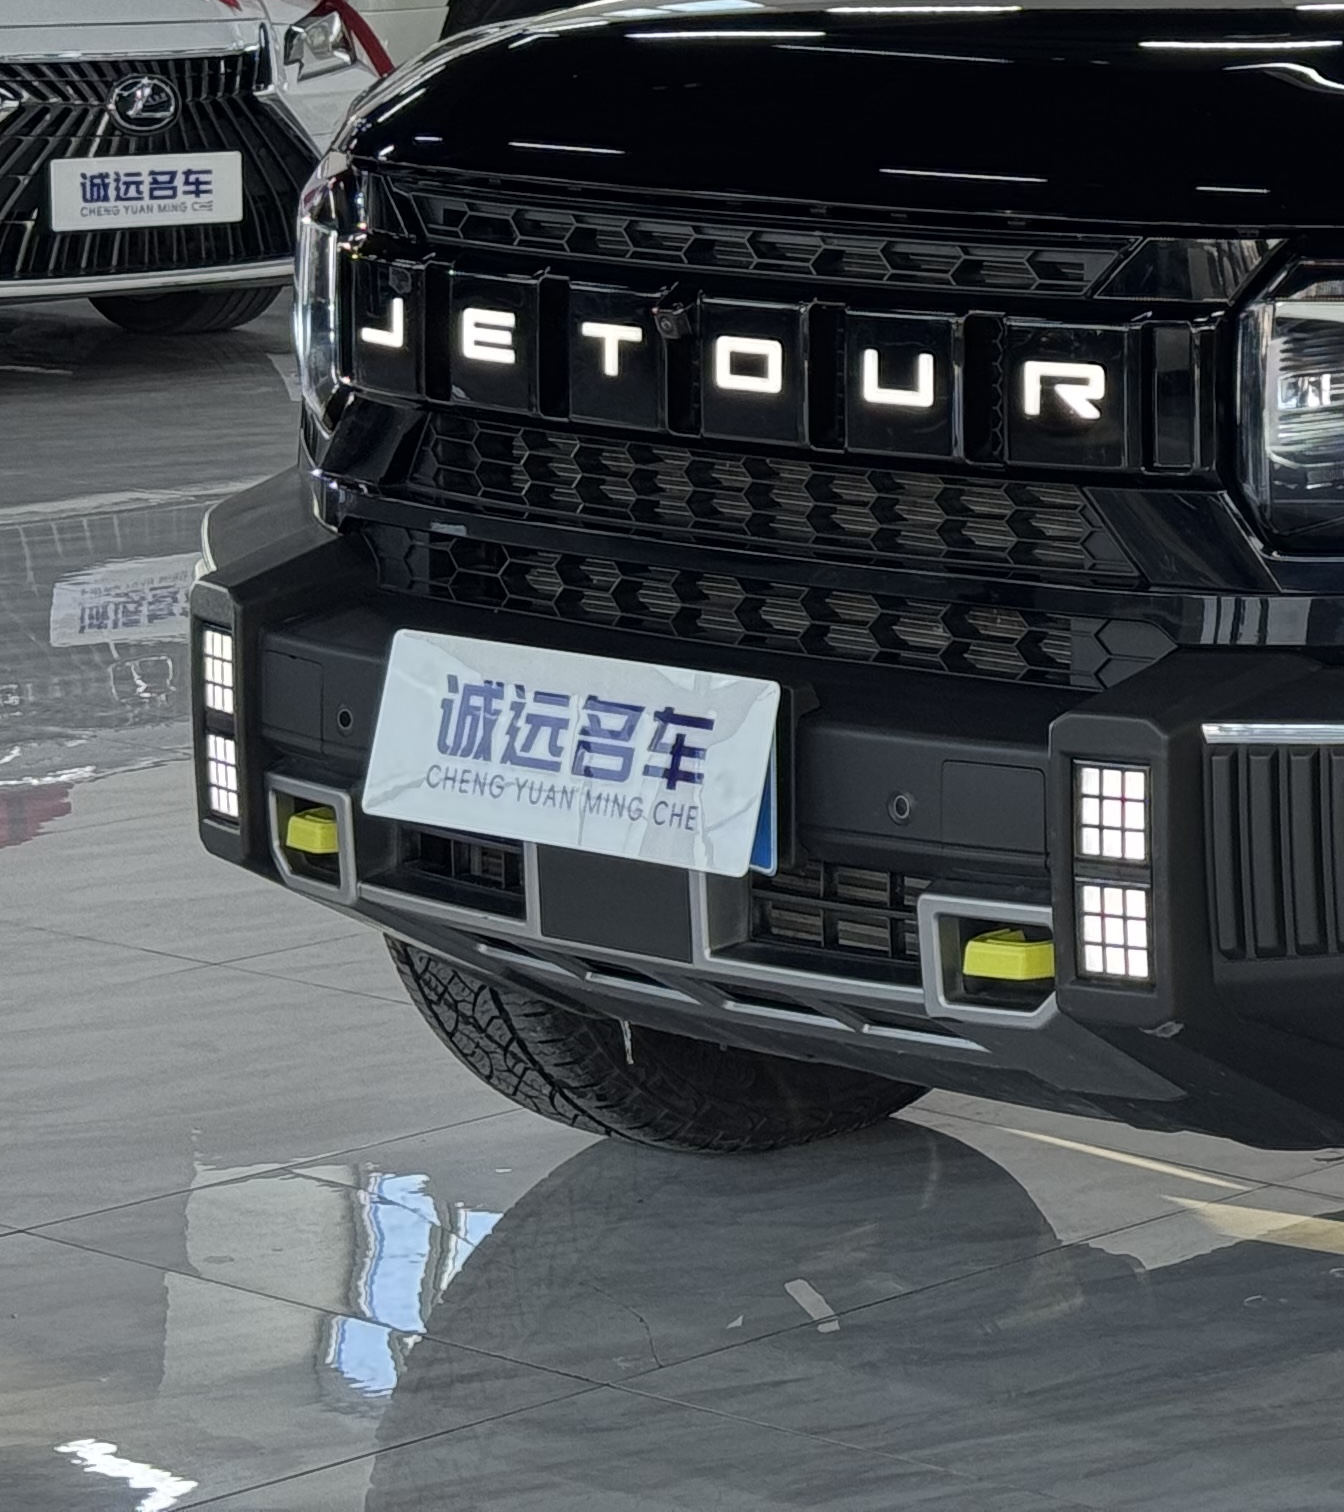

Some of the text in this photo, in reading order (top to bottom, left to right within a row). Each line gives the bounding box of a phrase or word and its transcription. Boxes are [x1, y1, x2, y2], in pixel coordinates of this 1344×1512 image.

[80, 169, 213, 203] 诚远名车
[80, 204, 120, 217] CHENG
[123, 204, 154, 215] YUAN
[157, 202, 187, 214] MING
[361, 297, 1106, 420] JETOUR
[437, 674, 715, 791] 诚远名车
[426, 764, 700, 832] CHENG YUAN MING CHE
